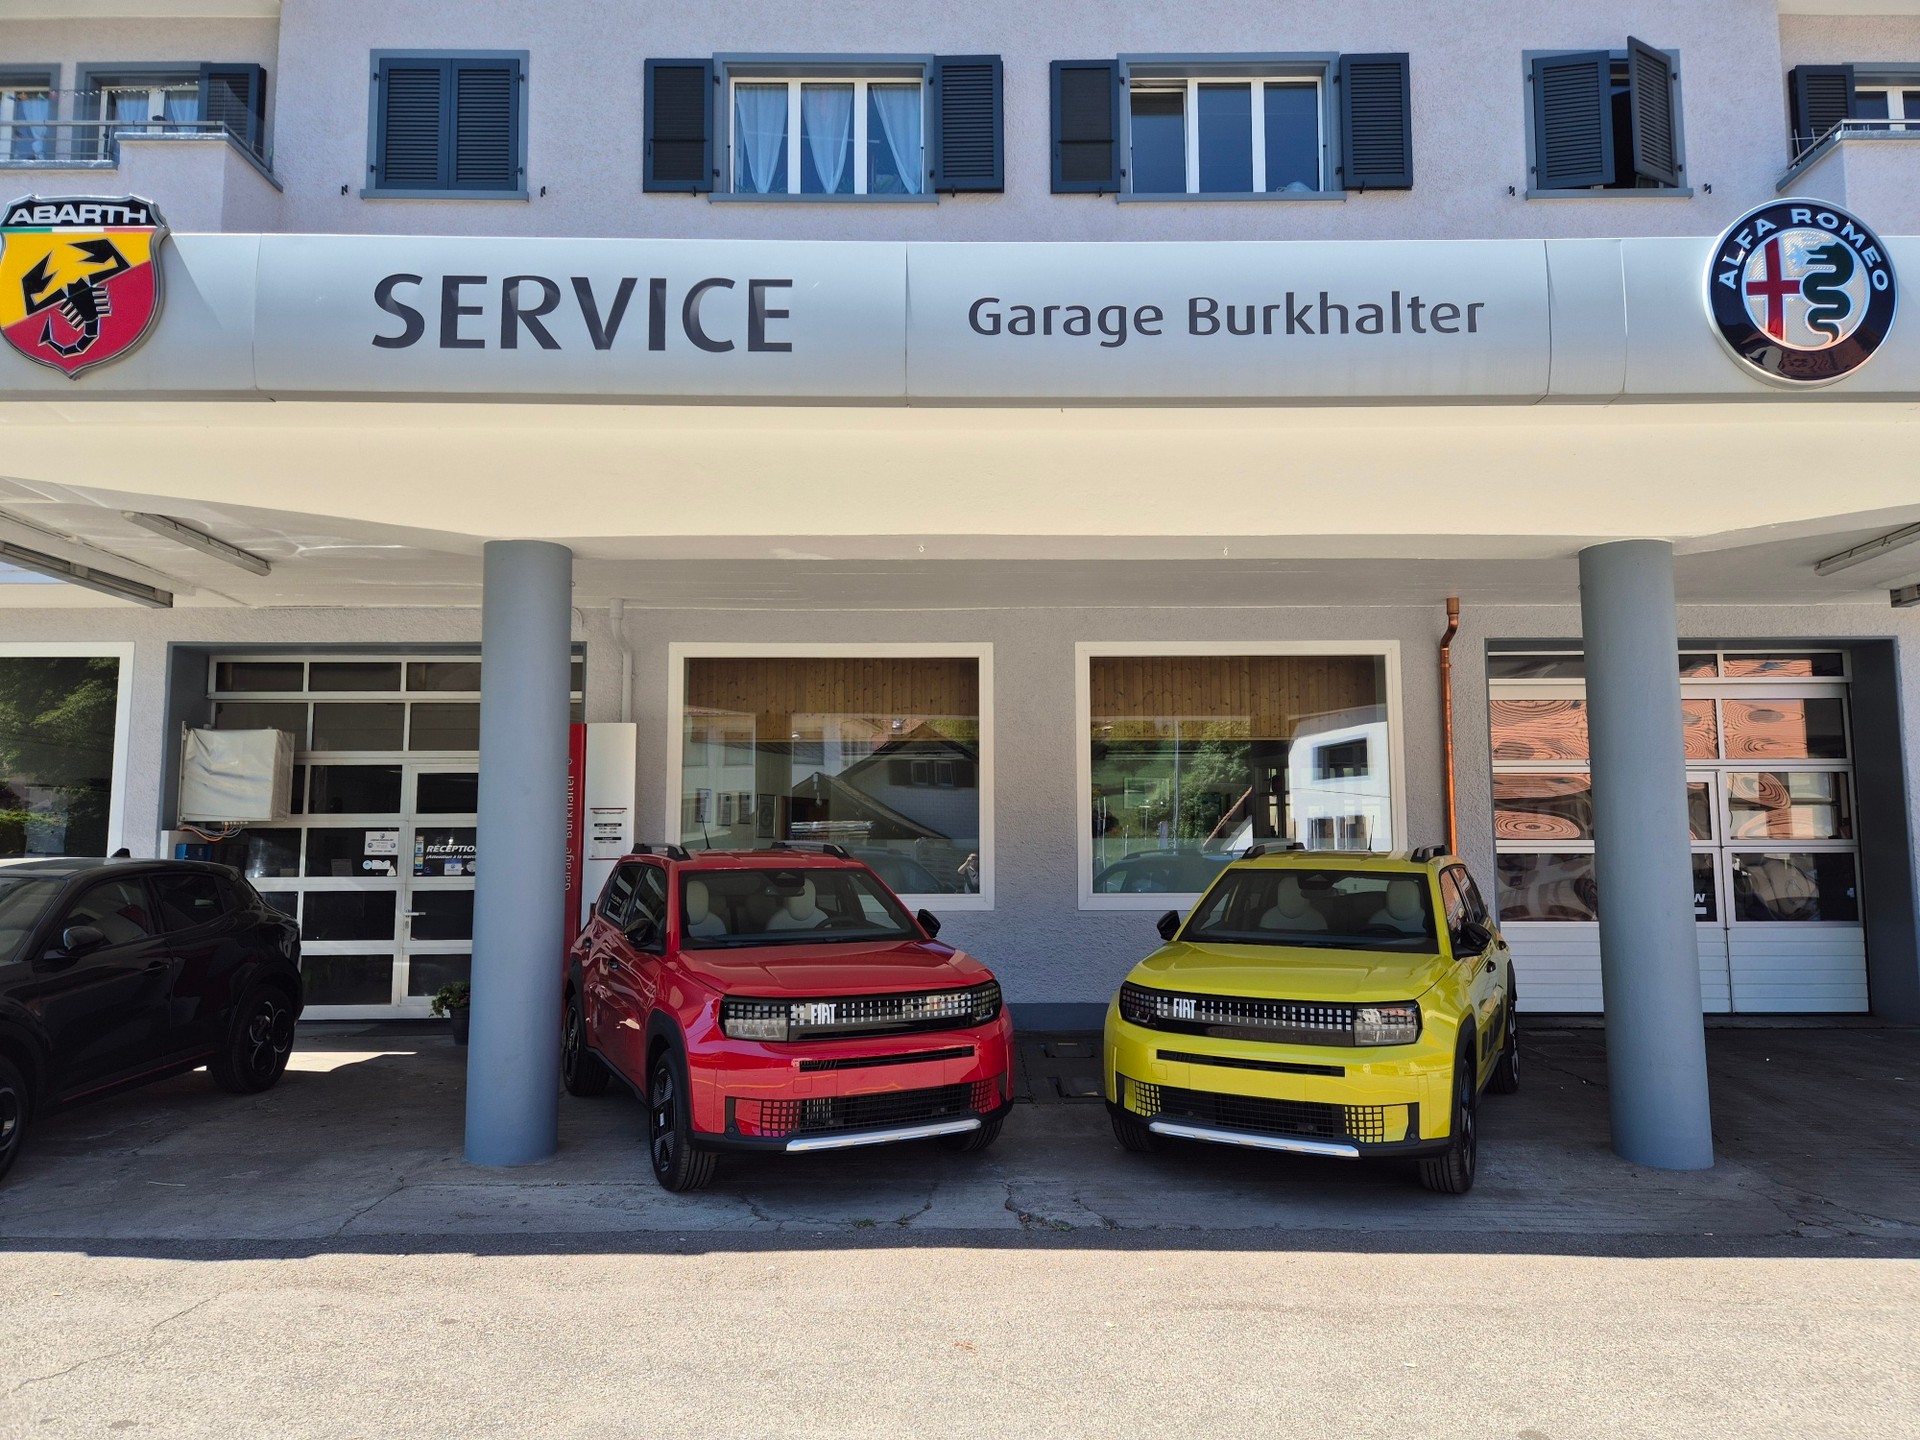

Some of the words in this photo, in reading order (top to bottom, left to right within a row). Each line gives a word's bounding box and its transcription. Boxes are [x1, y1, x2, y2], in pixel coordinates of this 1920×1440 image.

[7, 203, 147, 225] ABARTH
[1718, 218, 1777, 290] ALFA
[1790, 208, 1889, 292] ROMEO
[371, 273, 794, 353] SERVICE
[968, 296, 1164, 348] Garage
[1188, 290, 1485, 337] Burkhalter
[426, 844, 476, 853] RÉCEPTIO
[810, 1003, 837, 1025] FIAT
[1173, 997, 1197, 1019] FIAT
